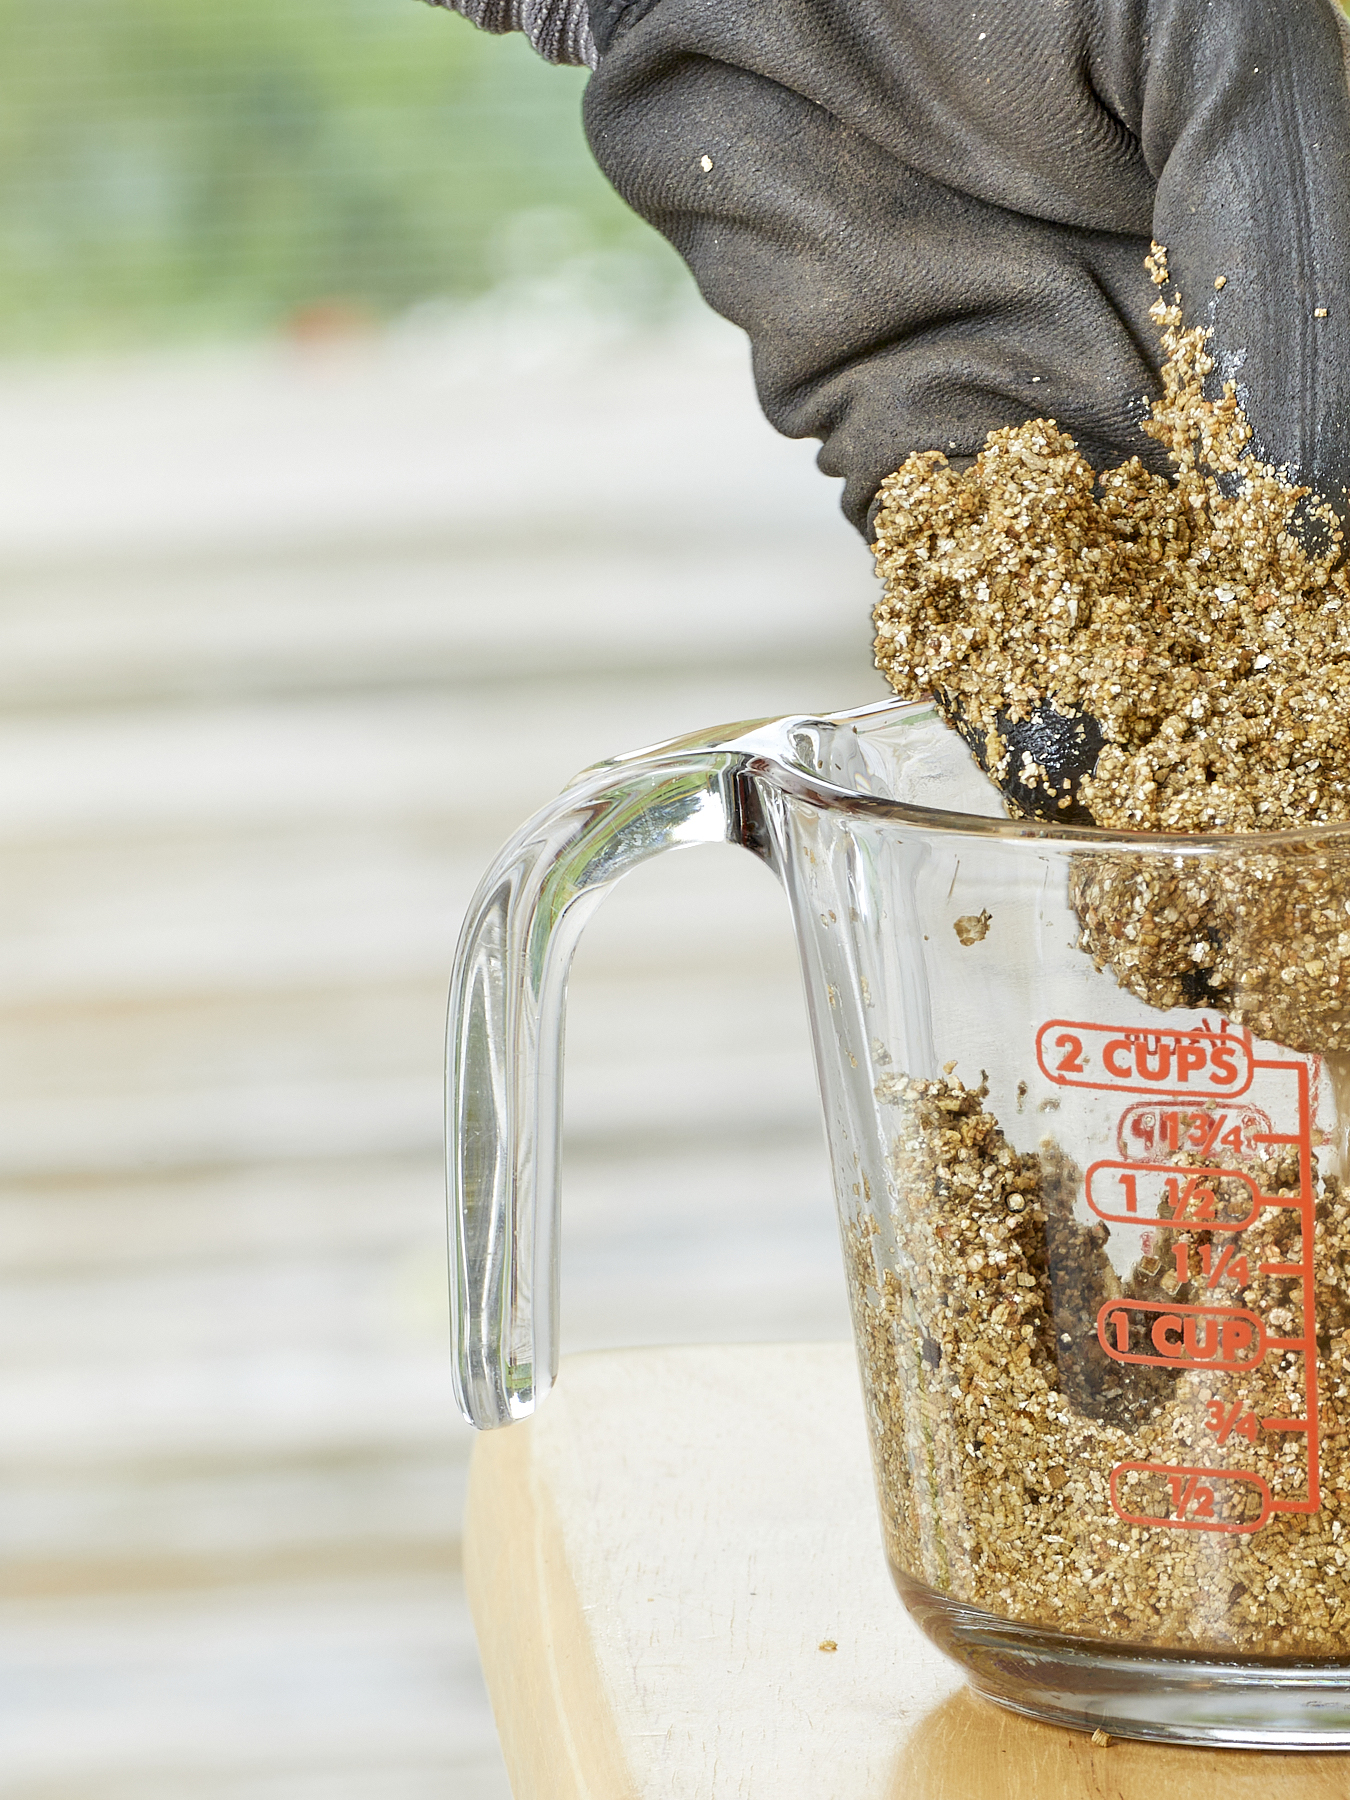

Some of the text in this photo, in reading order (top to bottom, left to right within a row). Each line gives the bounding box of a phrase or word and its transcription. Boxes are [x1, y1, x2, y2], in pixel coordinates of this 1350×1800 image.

[1055, 1034, 1084, 1073] 2
[1102, 1039, 1238, 1085] CUPS
[1118, 1174, 1137, 1213] 1
[1110, 1311, 1253, 1361] 1 CUP
[1204, 1400, 1258, 1444] 3/4
[1167, 1476, 1215, 1520] 1/2
